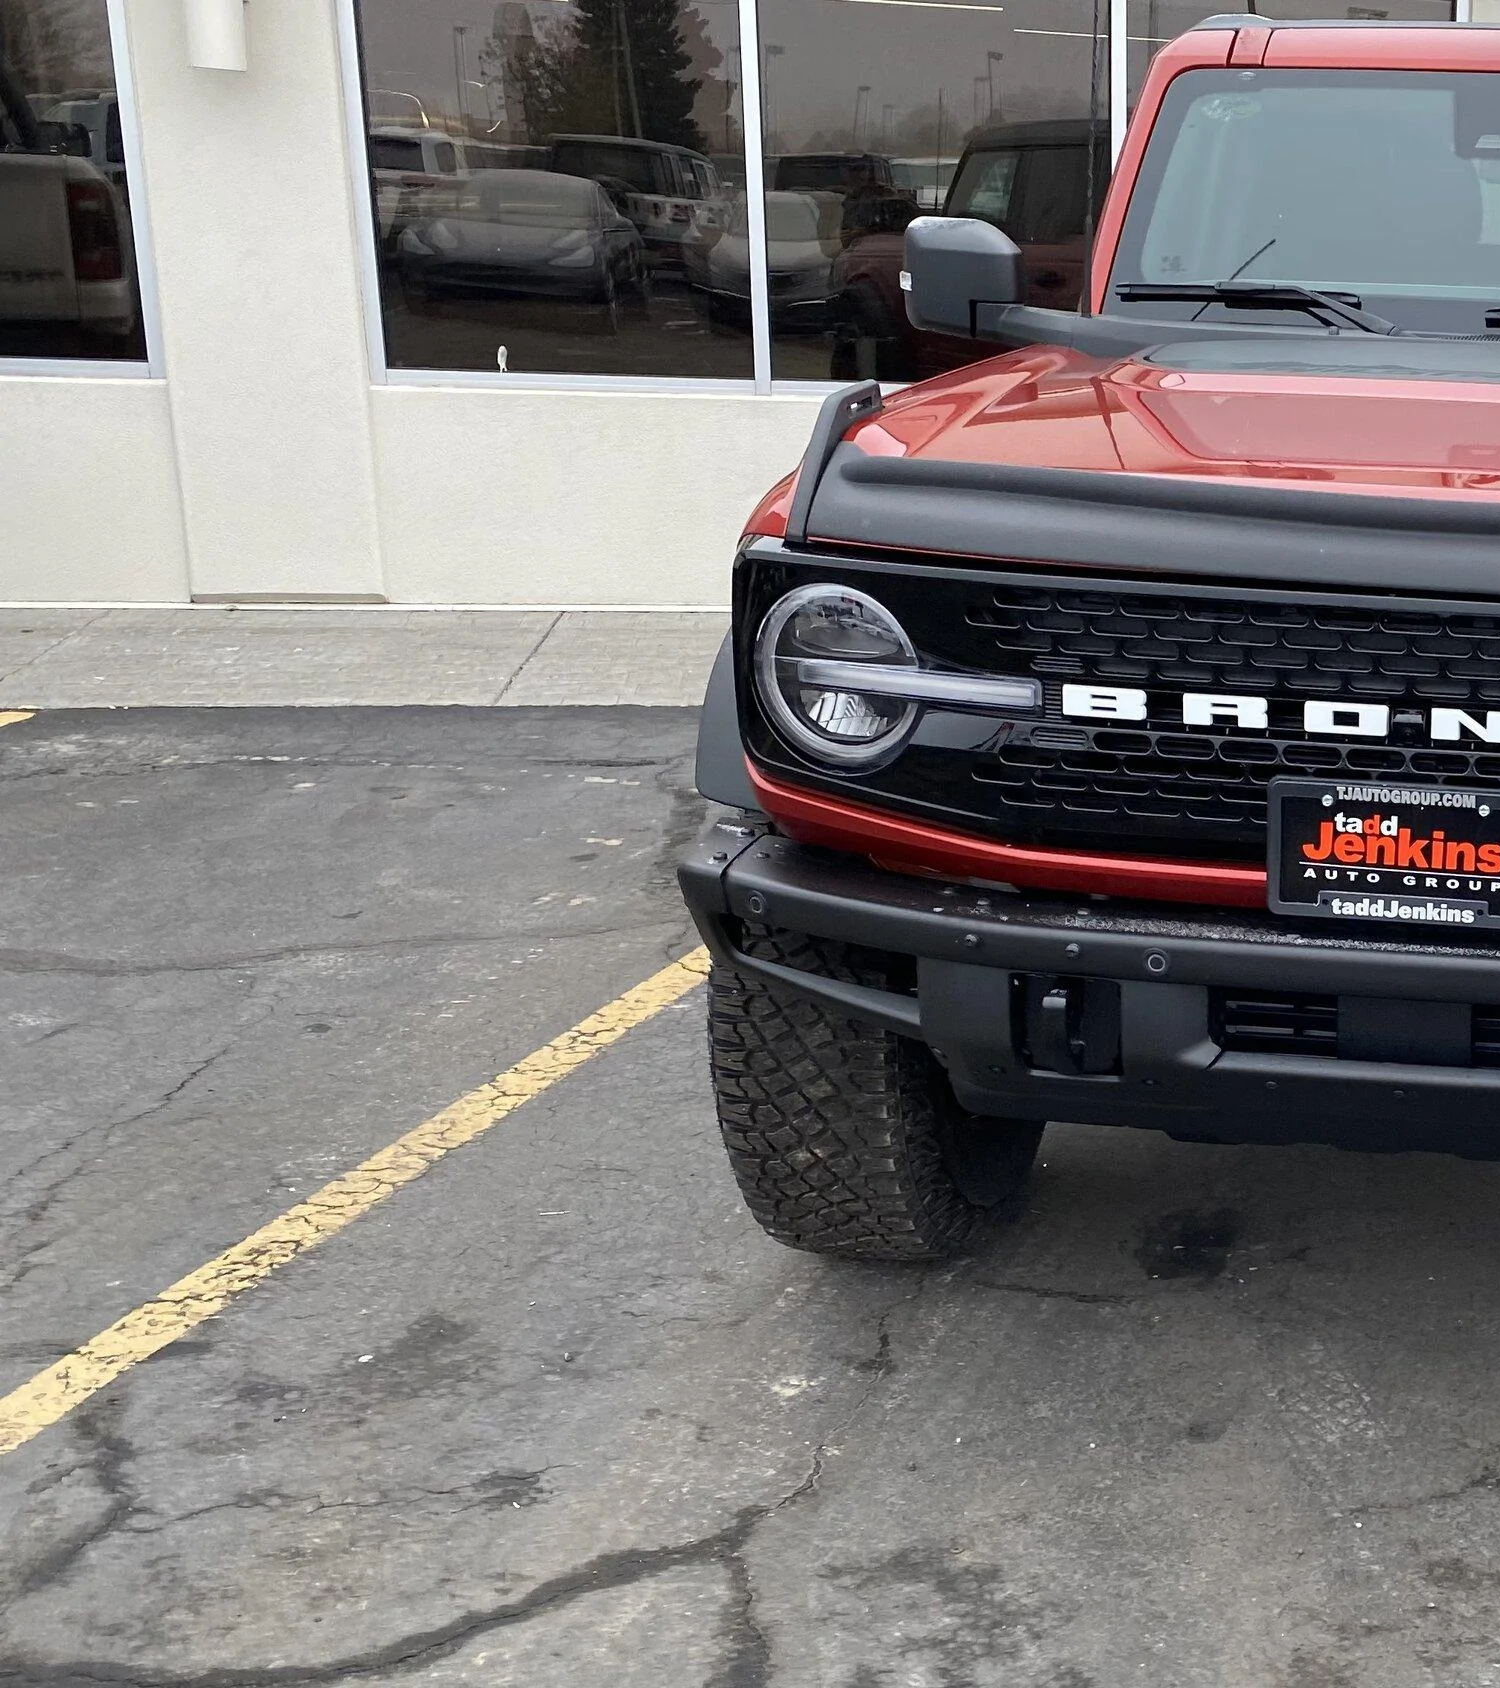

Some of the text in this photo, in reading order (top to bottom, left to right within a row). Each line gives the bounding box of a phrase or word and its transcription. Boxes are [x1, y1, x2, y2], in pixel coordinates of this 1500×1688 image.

[1336, 786, 1477, 809] TJAUTOGROUP.COM
[1334, 811, 1399, 837] tadd
[1303, 867, 1380, 884] AUTO
[1331, 897, 1475, 924] taddJenkins
